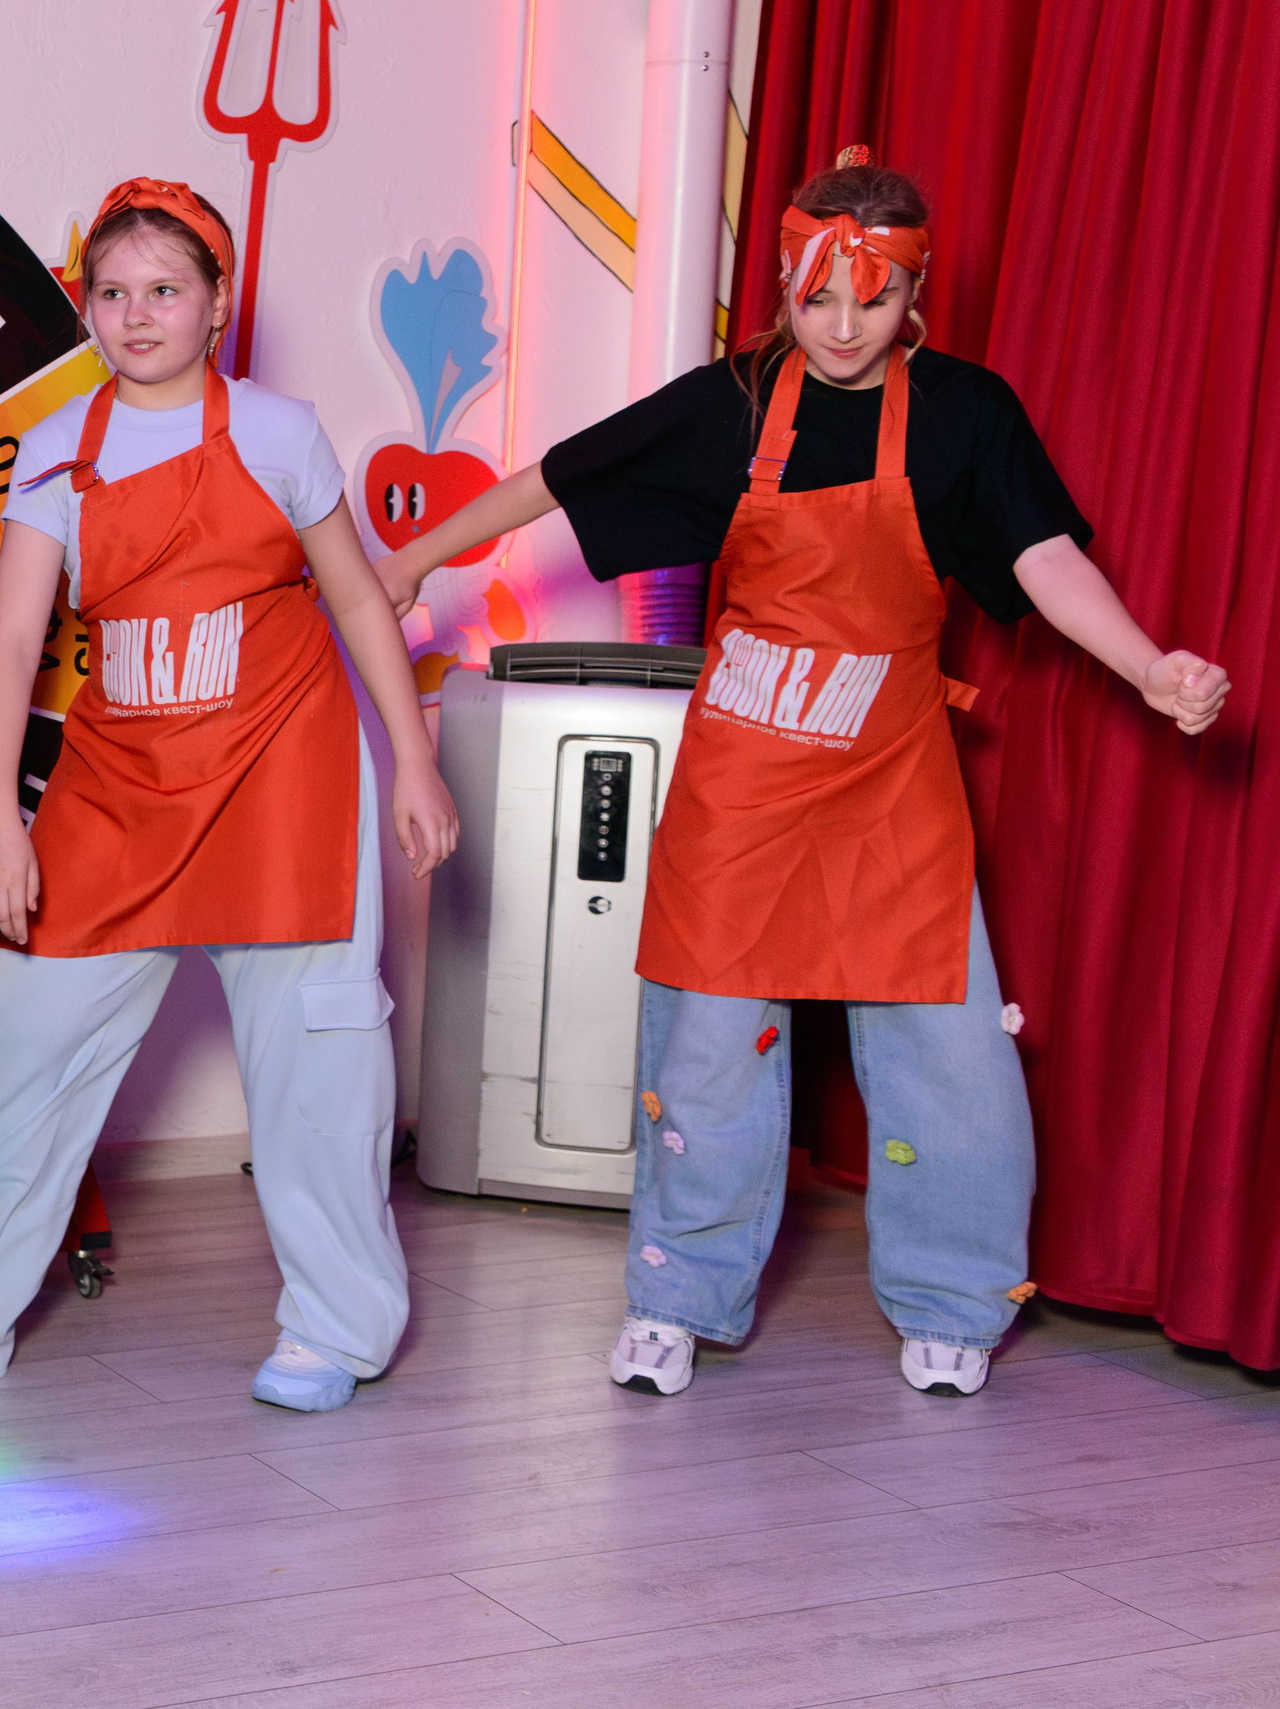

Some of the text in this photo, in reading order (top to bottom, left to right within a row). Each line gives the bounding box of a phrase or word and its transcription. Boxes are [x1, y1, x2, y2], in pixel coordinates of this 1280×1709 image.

[179, 601, 244, 703] RUN
[105, 698, 234, 718] нарное квест-шоу
[800, 653, 893, 738] RUN
